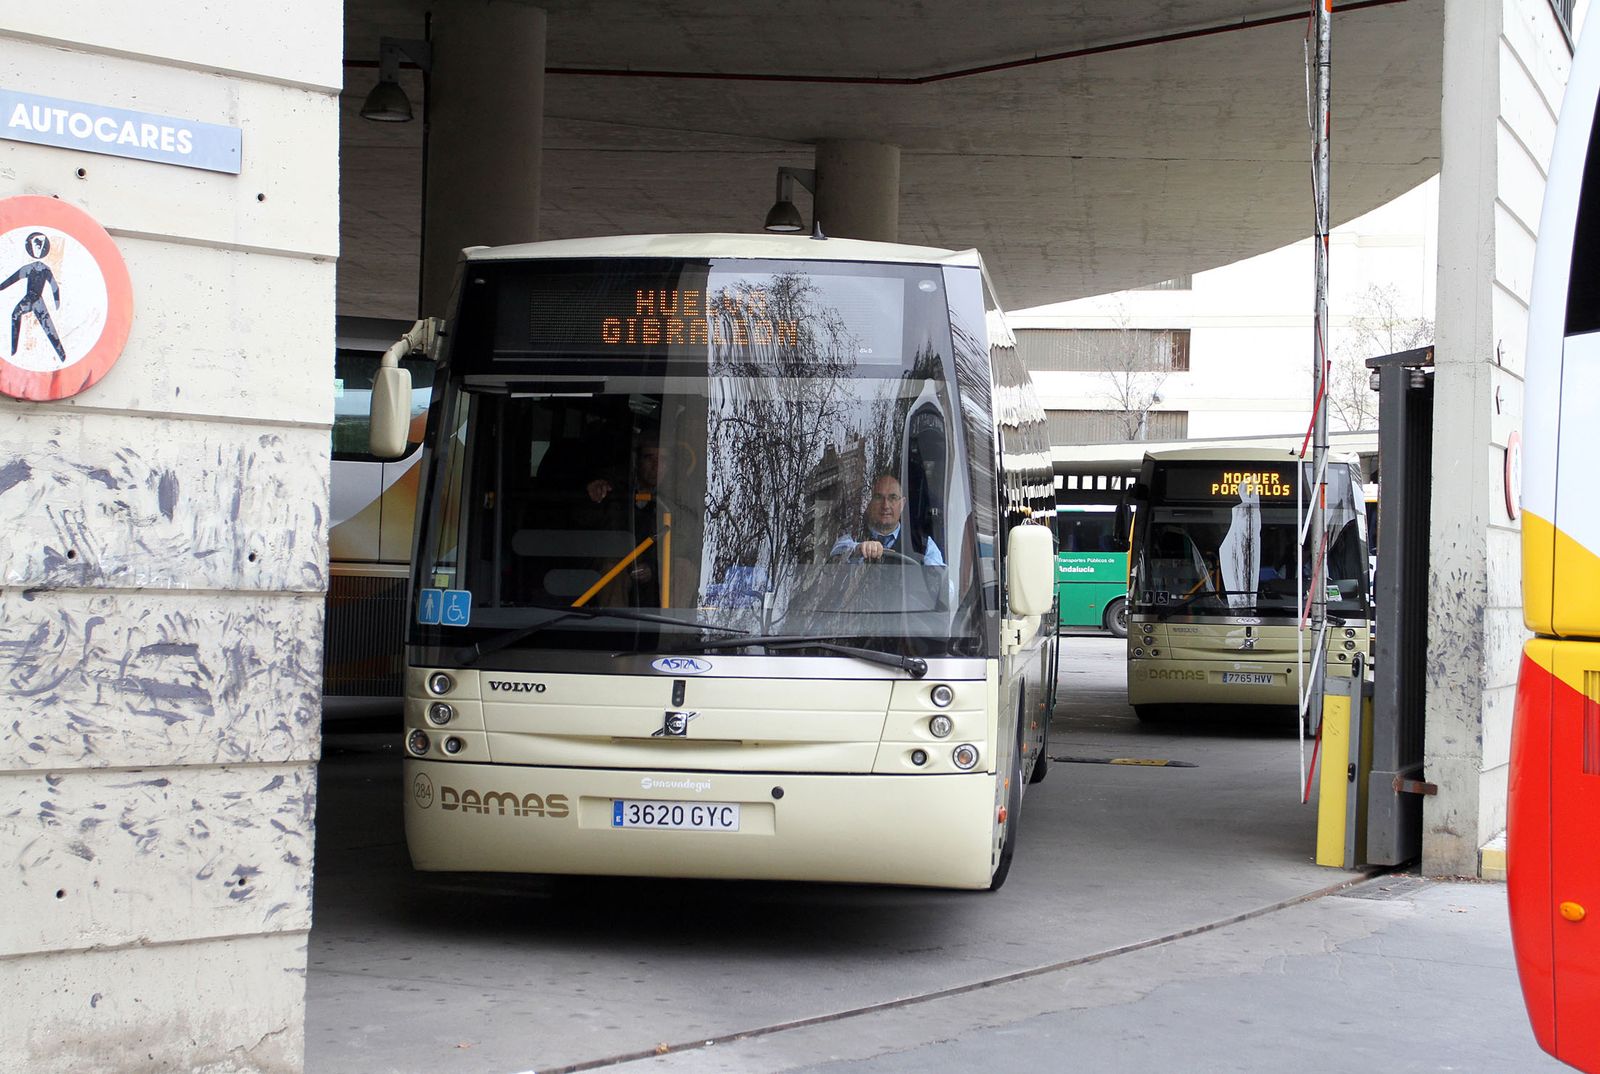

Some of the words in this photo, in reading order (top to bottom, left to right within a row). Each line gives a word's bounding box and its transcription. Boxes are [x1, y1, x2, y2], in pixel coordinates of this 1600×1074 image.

[8, 103, 193, 155] AUTOCARES
[636, 290, 767, 316] HUELVA
[602, 318, 799, 346] GIBRALEON
[1223, 472, 1280, 484] MOGUER
[1211, 483, 1239, 495] POR
[1246, 484, 1290, 496] PALOS
[1059, 565, 1095, 573] Andalucía
[661, 658, 702, 671] ASTRAL
[1149, 668, 1205, 680] DAMAS
[1228, 673, 1252, 683] 7765
[1254, 674, 1272, 684] HVV
[488, 680, 547, 693] VOLVO
[415, 782, 431, 799] 284
[440, 786, 570, 818] DAMAS
[628, 804, 684, 826] 3620
[691, 806, 733, 828] GYC
